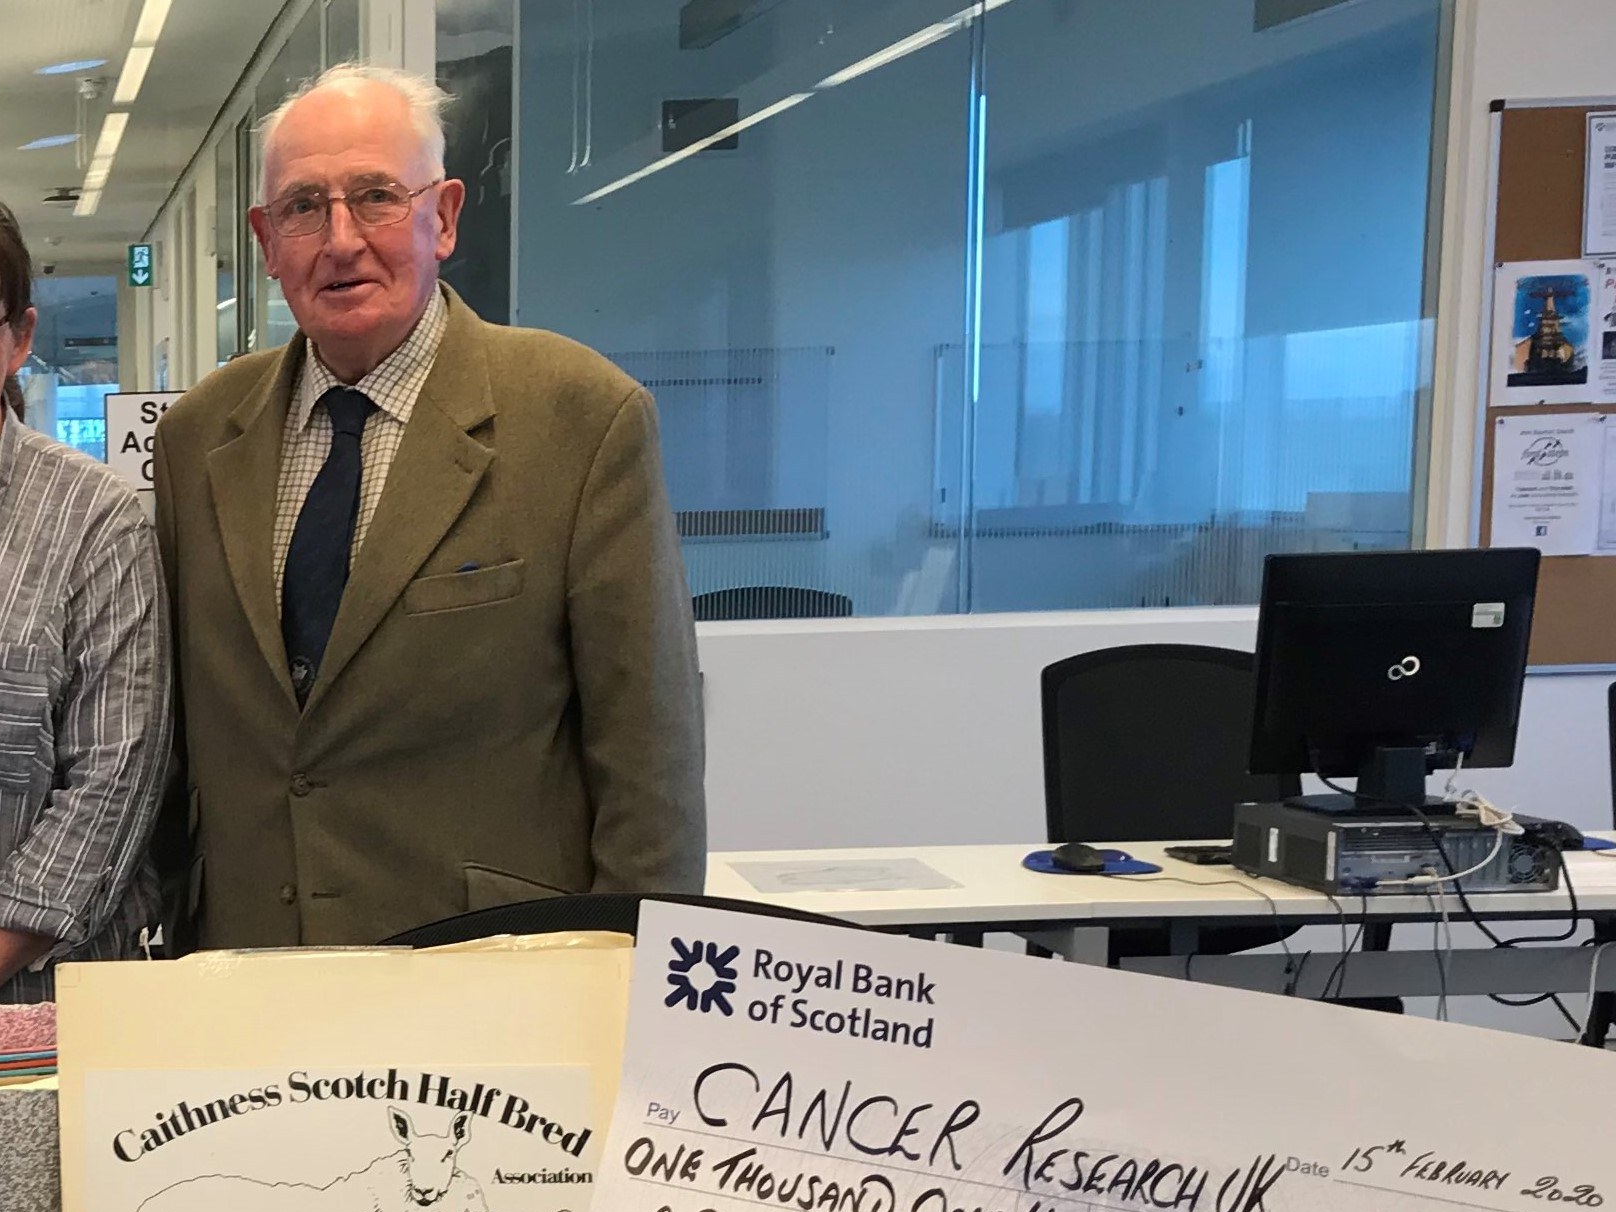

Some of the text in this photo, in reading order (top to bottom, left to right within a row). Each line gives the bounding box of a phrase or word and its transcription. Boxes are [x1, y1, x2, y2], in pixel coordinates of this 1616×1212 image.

[753, 948, 937, 1005] Royal Bank
[747, 995, 935, 1049] of Scotland
[112, 1068, 594, 1164] Caithness Scotch Half Bred
[646, 1101, 681, 1124] Pay
[693, 1062, 981, 1172] CANCER
[490, 1167, 594, 1187] Association
[623, 1136, 705, 1183] ONE
[1285, 1155, 1331, 1179] Date
[1520, 1177, 1605, 1208] 2020
